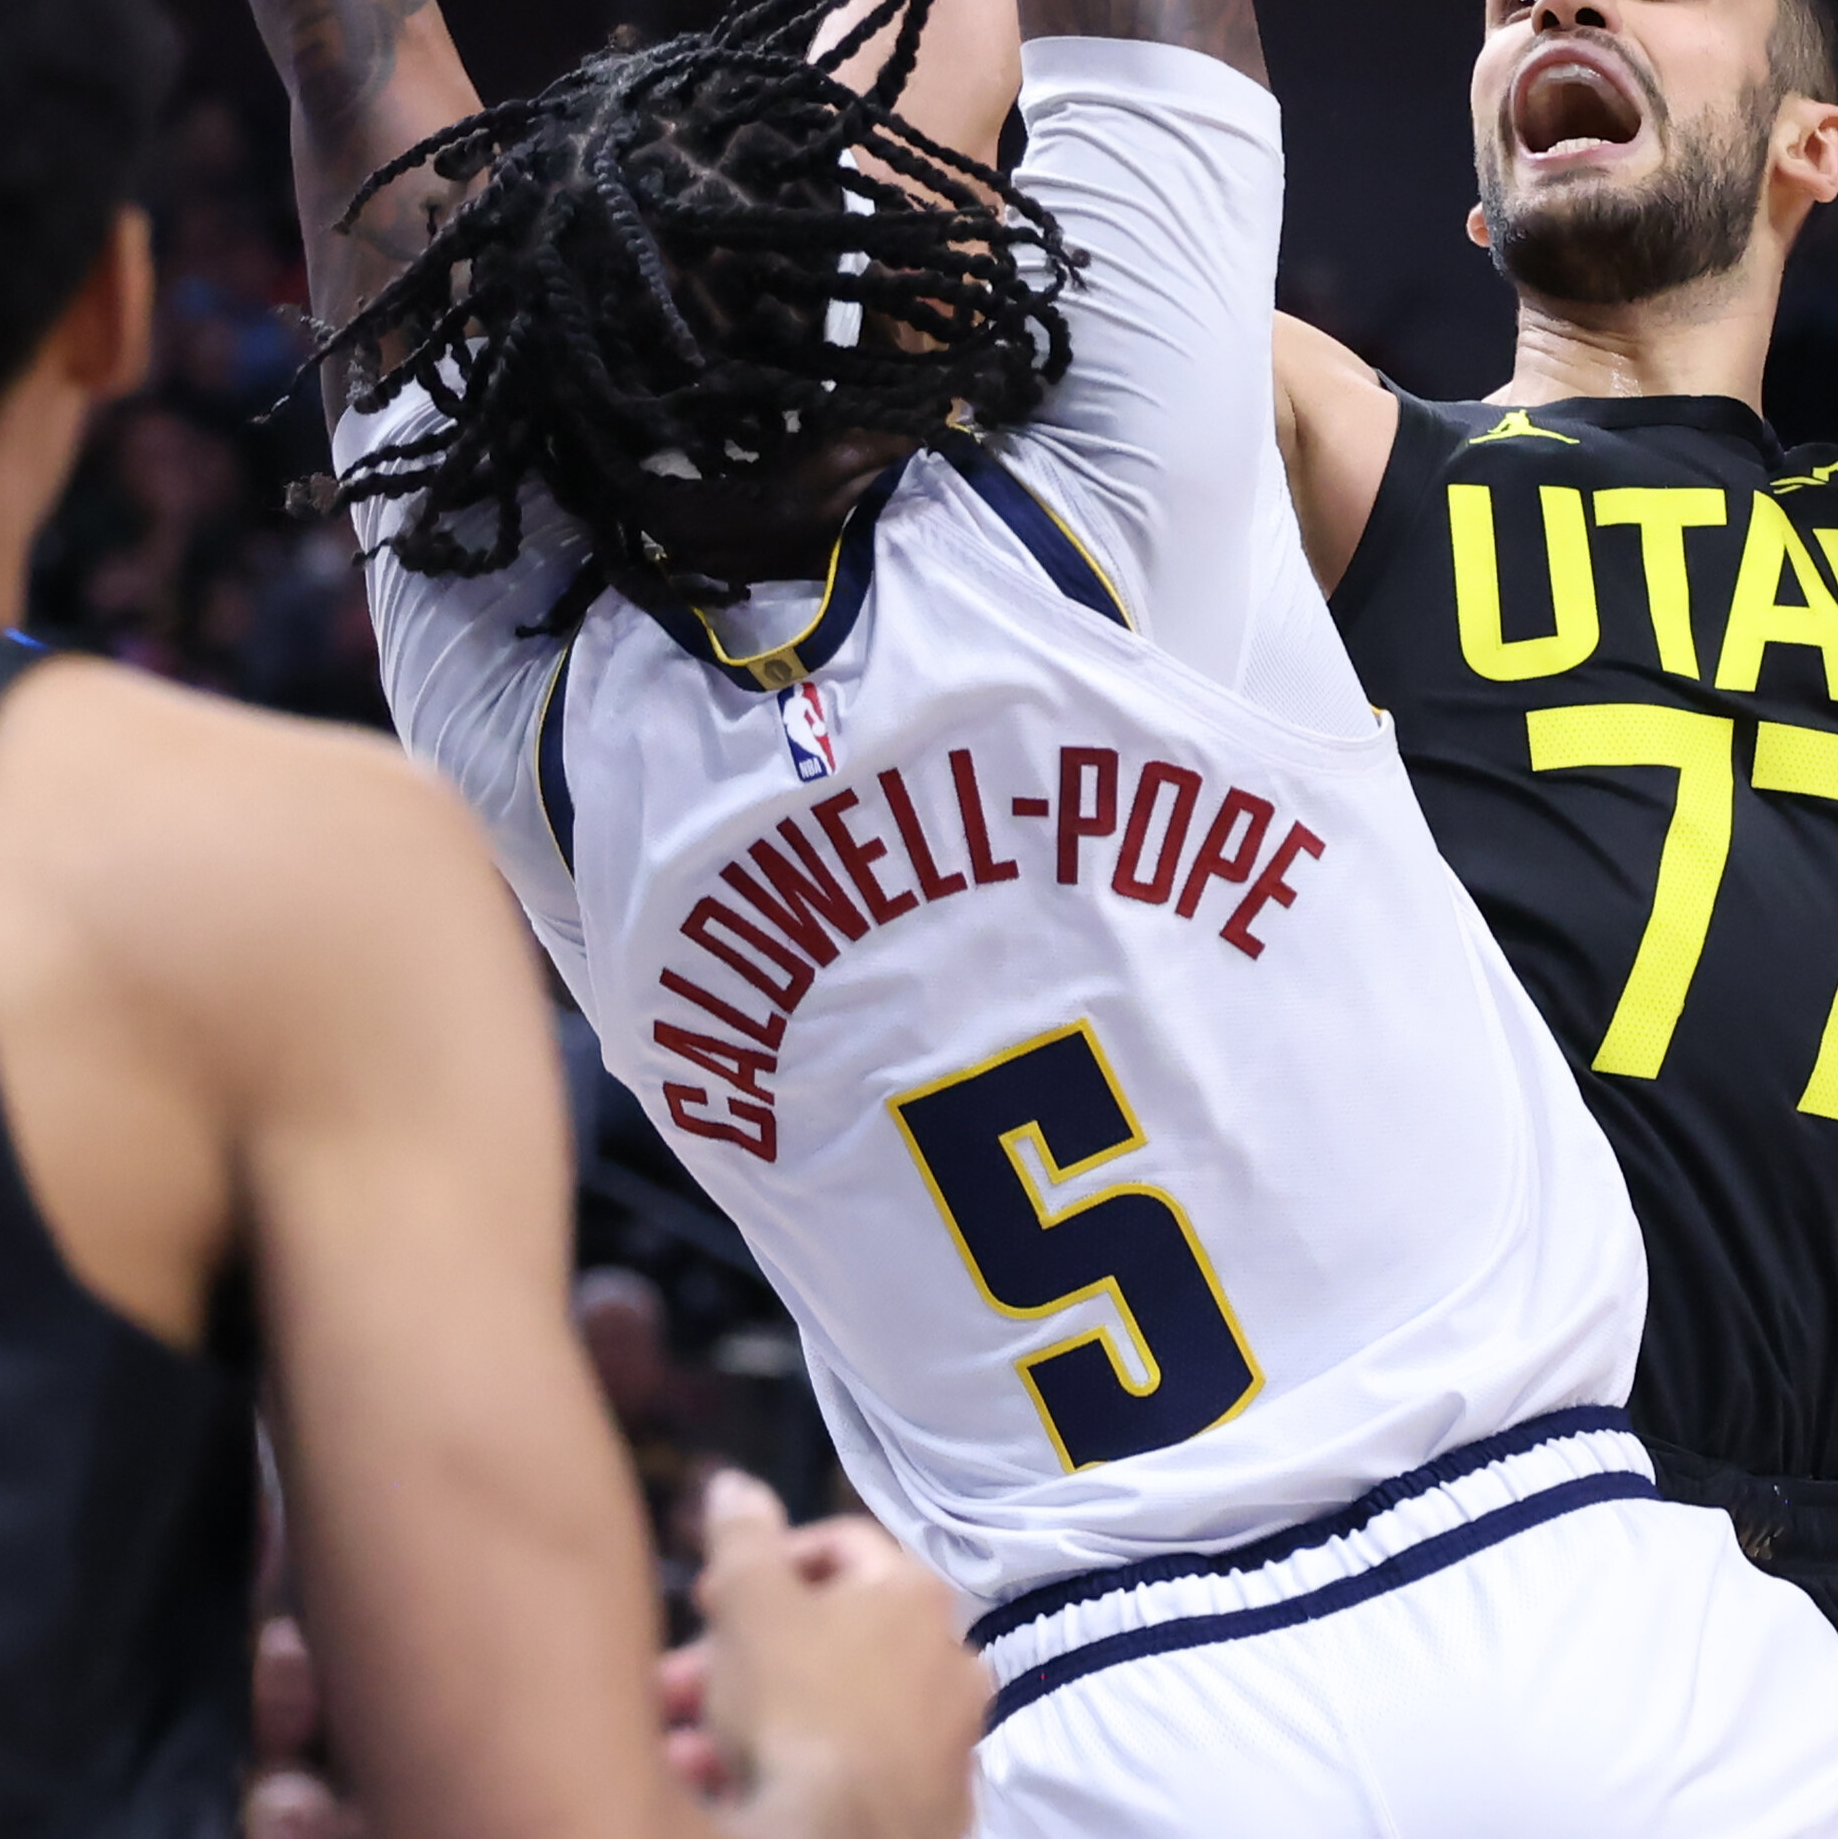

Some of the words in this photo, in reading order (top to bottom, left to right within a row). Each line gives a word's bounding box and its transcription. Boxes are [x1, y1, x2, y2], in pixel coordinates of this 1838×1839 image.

[652, 745, 1326, 1163] CALDWELL-POPE
[799, 756, 823, 779] NBA
[887, 1017, 1266, 1474] 5
